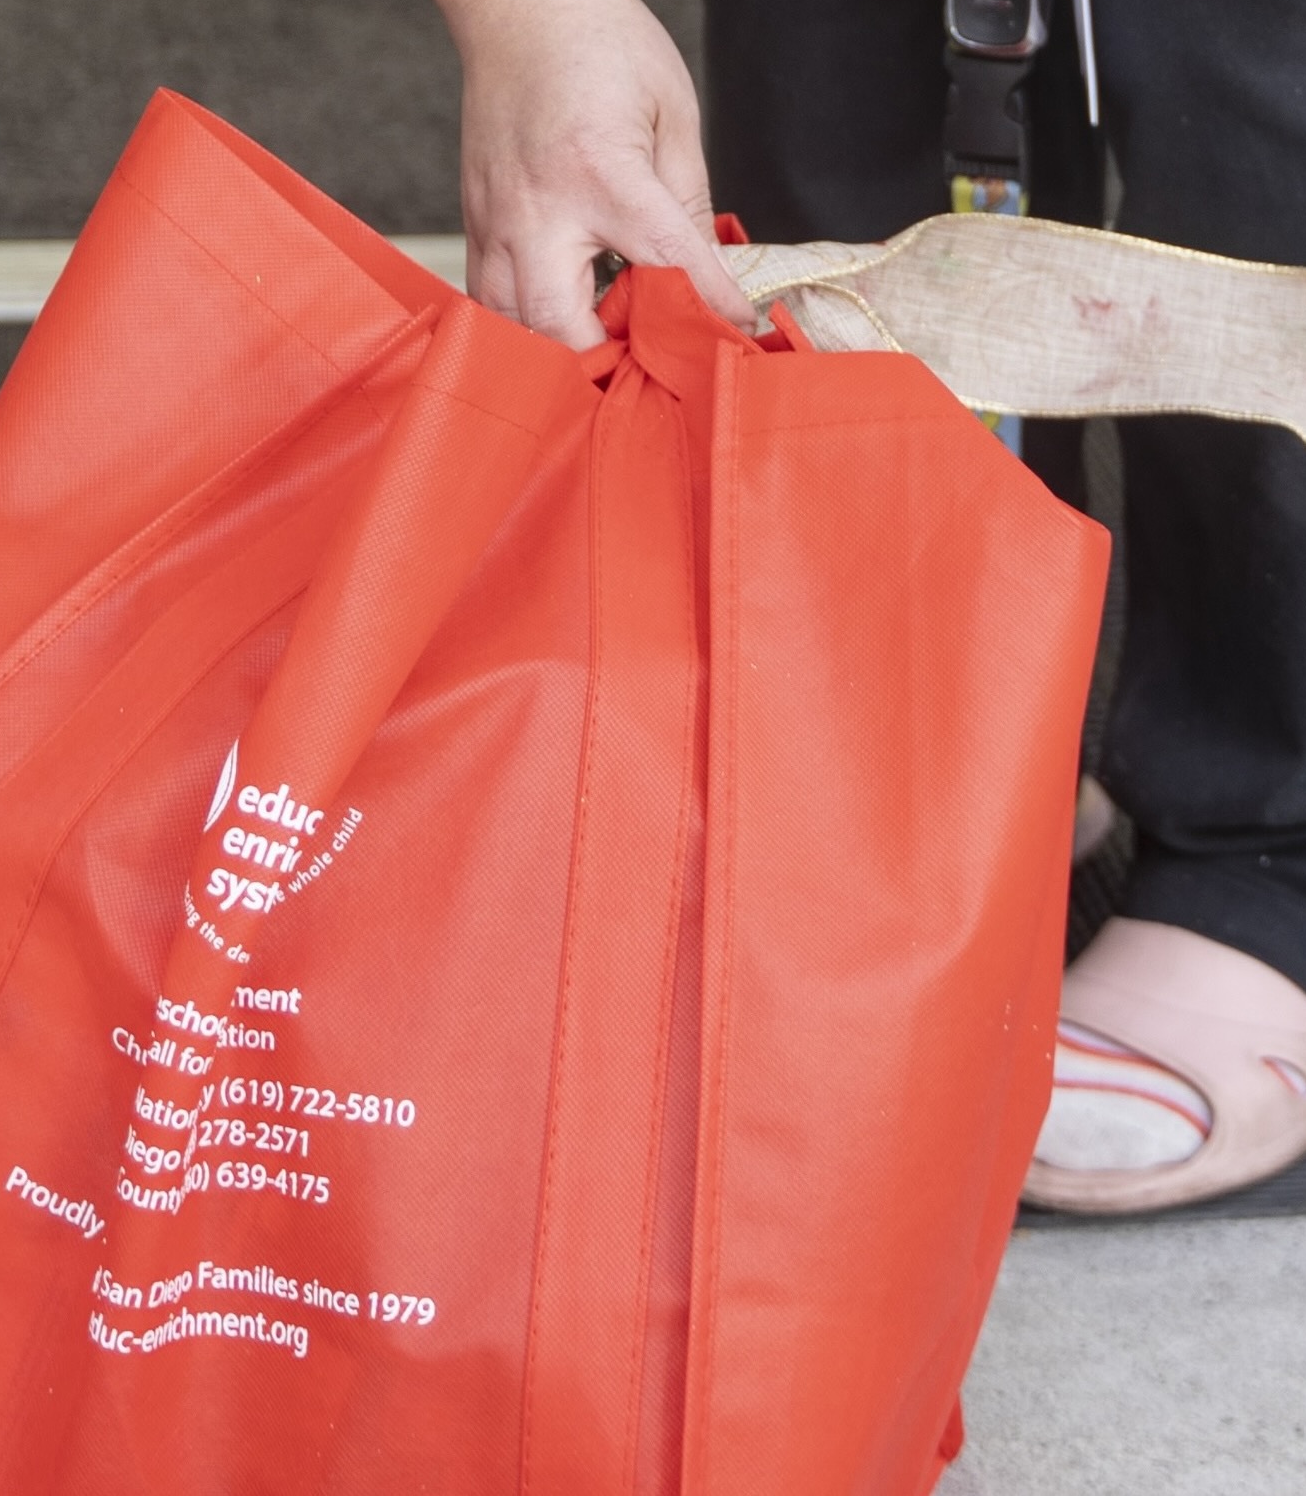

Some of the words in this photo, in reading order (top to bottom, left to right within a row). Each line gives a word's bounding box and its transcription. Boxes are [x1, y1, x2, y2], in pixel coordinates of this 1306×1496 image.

[238, 783, 324, 836] educ
[223, 826, 302, 873] enri
[199, 921, 225, 950] the
[288, 851, 333, 894] whole
[332, 807, 364, 852] child
[206, 867, 280, 914] syst
[148, 1037, 177, 1068] all
[220, 1076, 283, 1112] (619)
[290, 1084, 416, 1127] 722-5810
[198, 1119, 309, 1158] 278-2571
[216, 1161, 330, 1203] 639-4175
[5, 1165, 105, 1239] Proudly
[101, 1269, 143, 1309] San
[148, 1270, 193, 1309] Diego
[197, 1261, 298, 1300] Families
[303, 1279, 360, 1316] since
[368, 1291, 437, 1326] 1979
